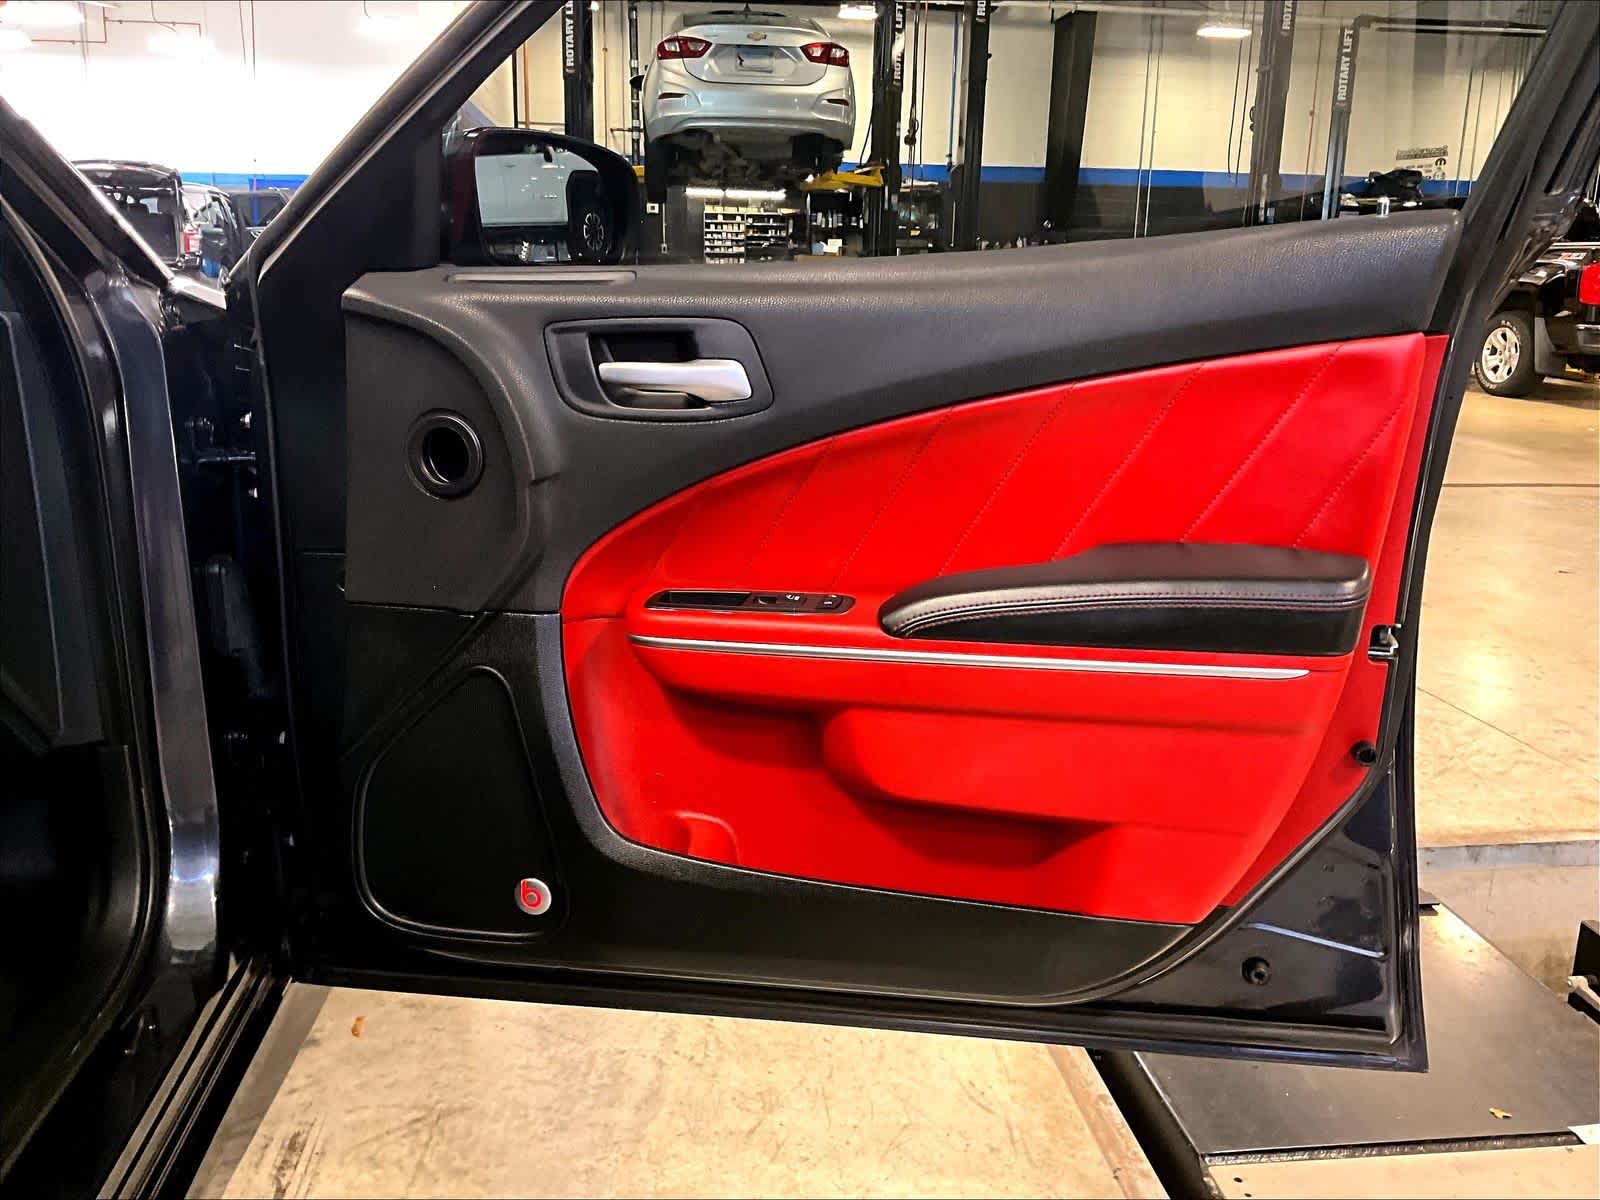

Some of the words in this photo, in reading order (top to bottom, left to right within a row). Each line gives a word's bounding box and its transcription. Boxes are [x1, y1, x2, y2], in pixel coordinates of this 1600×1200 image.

[895, 2, 904, 29] LIFT
[565, 18, 575, 67] ROTARY
[1342, 28, 1354, 53] LIFT
[1337, 55, 1351, 101] ROTARY
